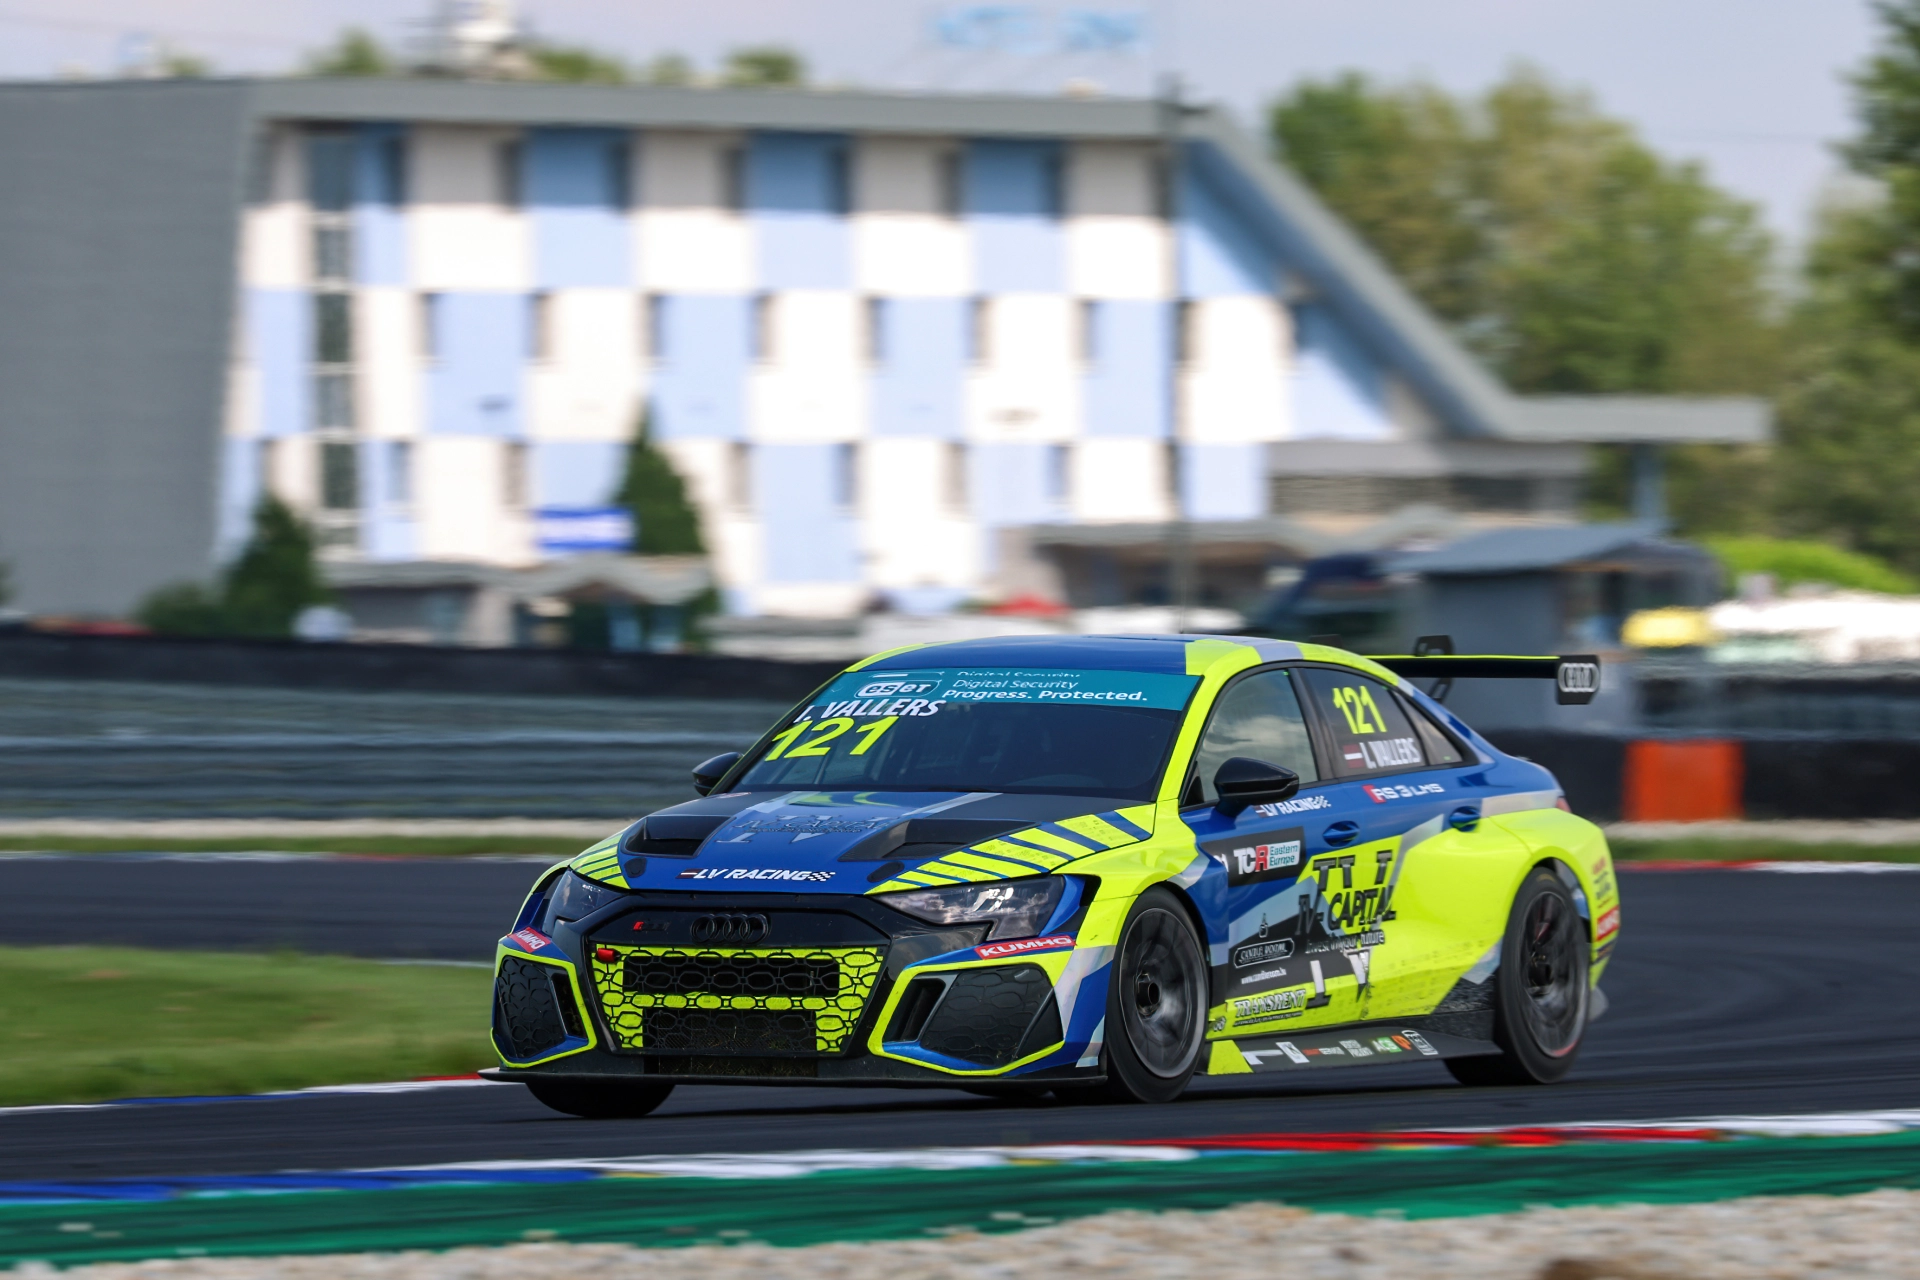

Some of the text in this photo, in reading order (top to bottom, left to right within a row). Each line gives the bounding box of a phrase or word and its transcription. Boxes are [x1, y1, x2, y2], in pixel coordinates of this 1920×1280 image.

[952, 679, 1079, 690] Digital Security
[942, 690, 1148, 701] Progress. Protected.
[821, 699, 946, 717] VALLERS
[1333, 685, 1387, 734] 121
[765, 716, 899, 761] 121
[1368, 738, 1421, 767] VALLERS
[1409, 783, 1445, 796] LMS
[1275, 797, 1320, 815] RACING
[1233, 845, 1269, 875] TCR
[1269, 844, 1298, 856] Eastern
[1269, 854, 1296, 866] Europe
[693, 868, 813, 881] LV RACING
[516, 929, 546, 950] KUMHO
[979, 936, 1072, 958] KUMHO
[1234, 989, 1306, 1018] TRANSRENT
